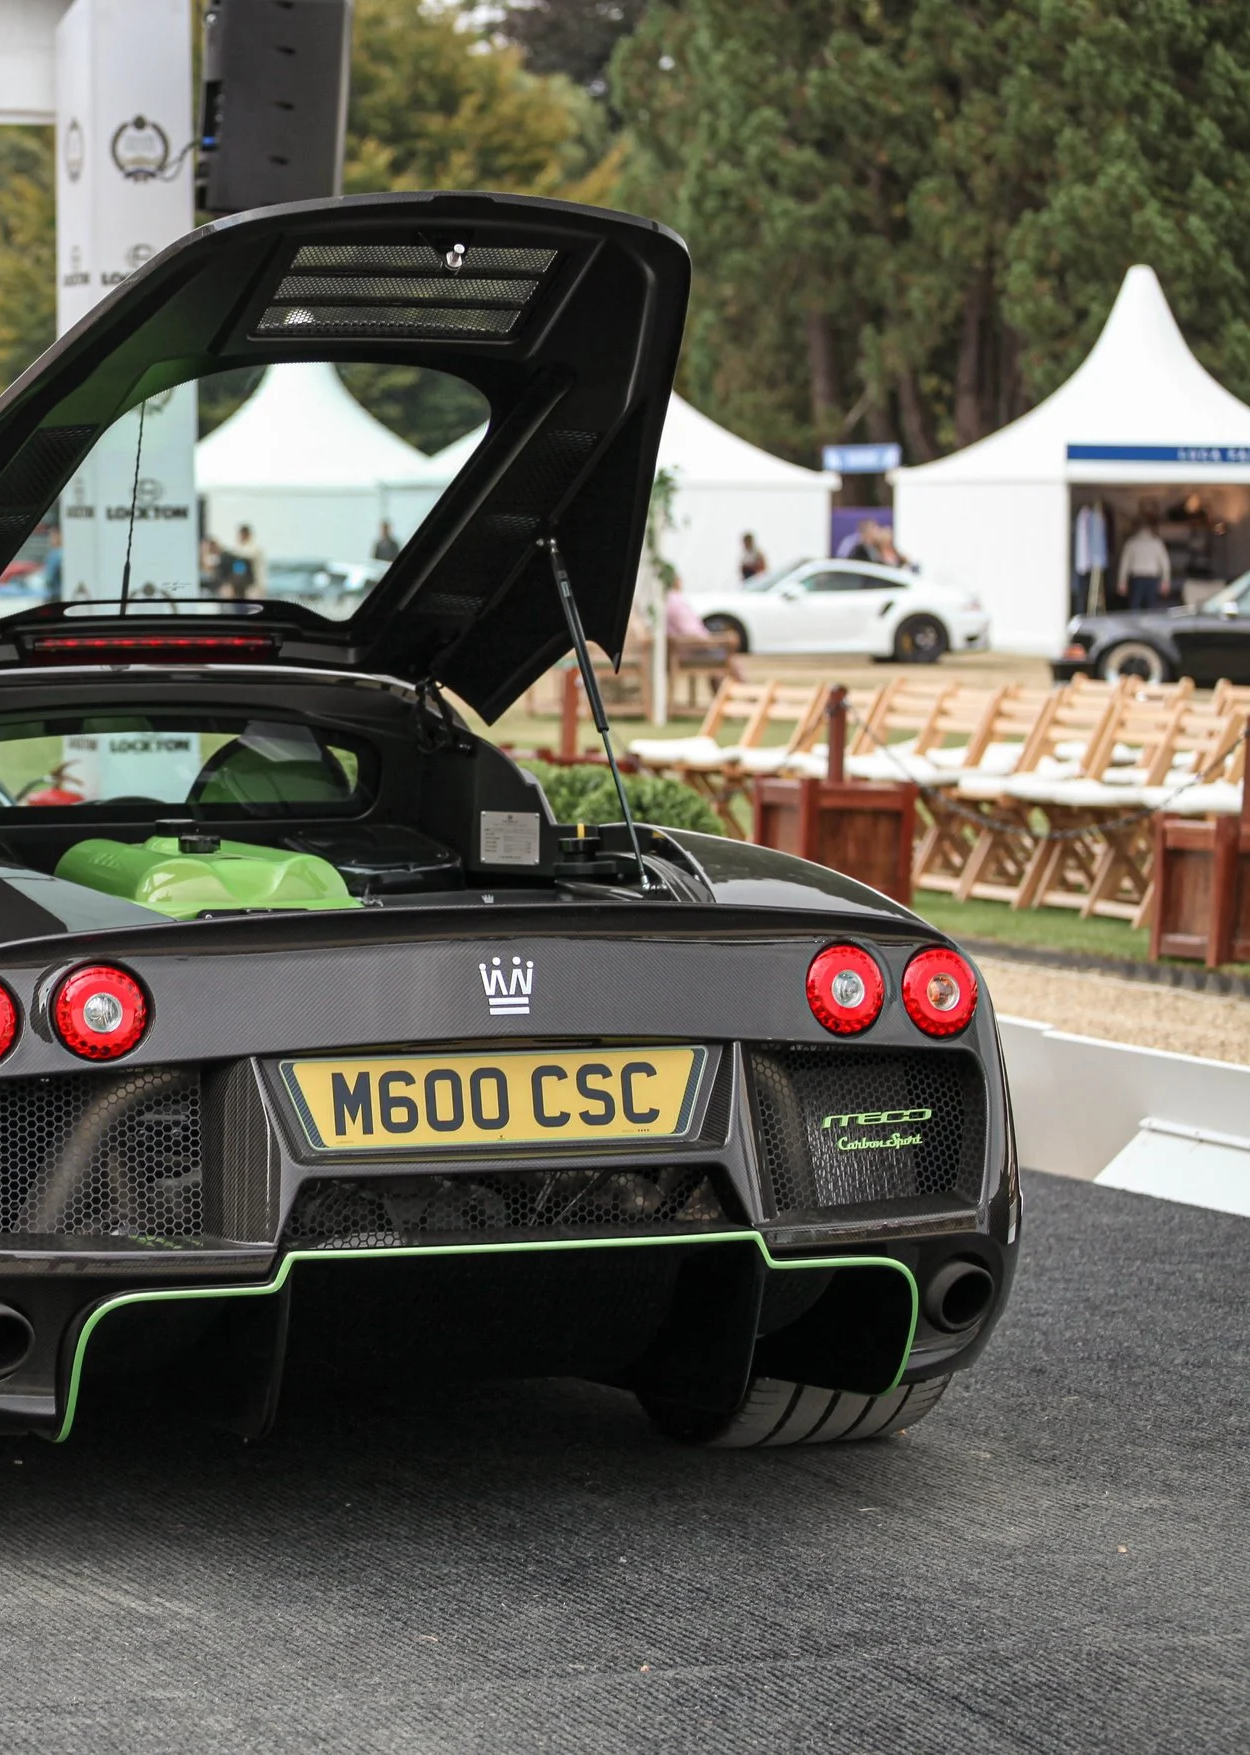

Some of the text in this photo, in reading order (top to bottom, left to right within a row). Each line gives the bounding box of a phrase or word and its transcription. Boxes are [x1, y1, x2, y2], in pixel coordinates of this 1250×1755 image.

[331, 1061, 661, 1136] M600 CSC
[837, 1132, 923, 1150] Carbon Sport
